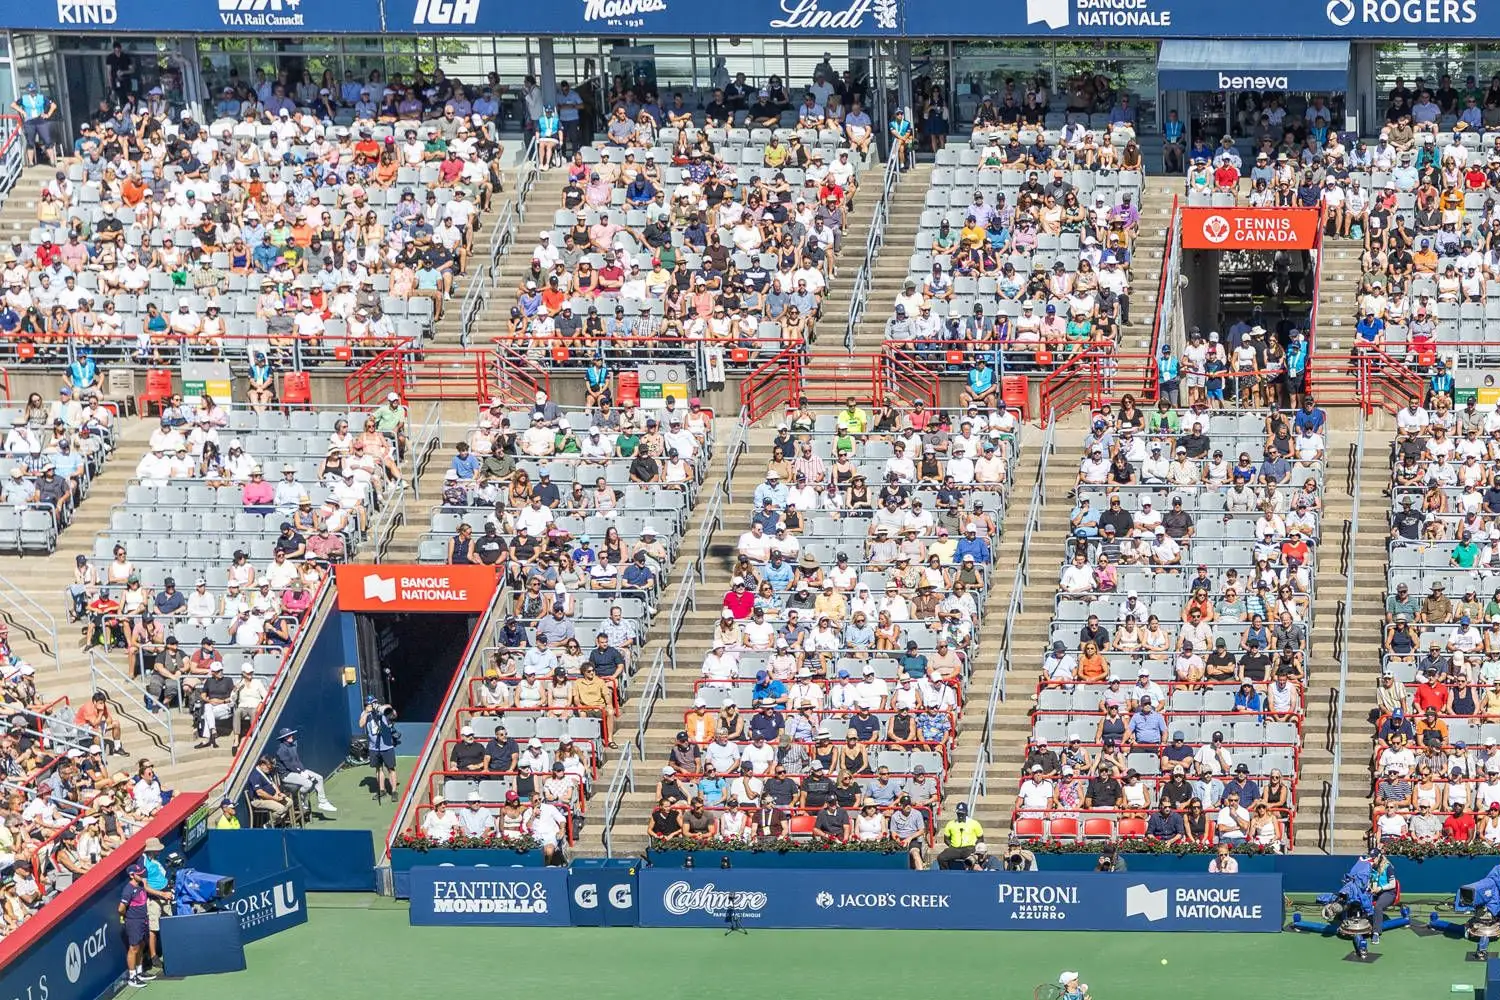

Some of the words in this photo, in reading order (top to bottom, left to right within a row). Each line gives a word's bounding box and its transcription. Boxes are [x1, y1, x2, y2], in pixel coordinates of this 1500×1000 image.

[58, 4, 117, 25] KIND
[413, 0, 480, 24] IGA
[770, 0, 873, 28] Lindt
[1077, 11, 1171, 26] NATIONALE
[1363, 0, 1477, 23] ROGERS
[220, 13, 244, 25] VIA
[245, 13, 265, 25] Rail
[1219, 72, 1288, 89] beneva
[1235, 217, 1290, 230] TENNIS
[1235, 230, 1298, 242] CANADA
[401, 577, 450, 589] BANQUE
[401, 589, 467, 601] NATIONALE
[663, 881, 767, 915] Cashmere
[837, 892, 896, 908] JACOB'S
[899, 893, 950, 907] CREEK
[1175, 888, 1240, 902] BANQUE
[434, 899, 548, 913] MONDELLO
[1019, 904, 1057, 912] NASTRO
[1175, 905, 1262, 919] NATIONALE
[1010, 911, 1066, 920] AZZURRO
[83, 923, 108, 964] razr
